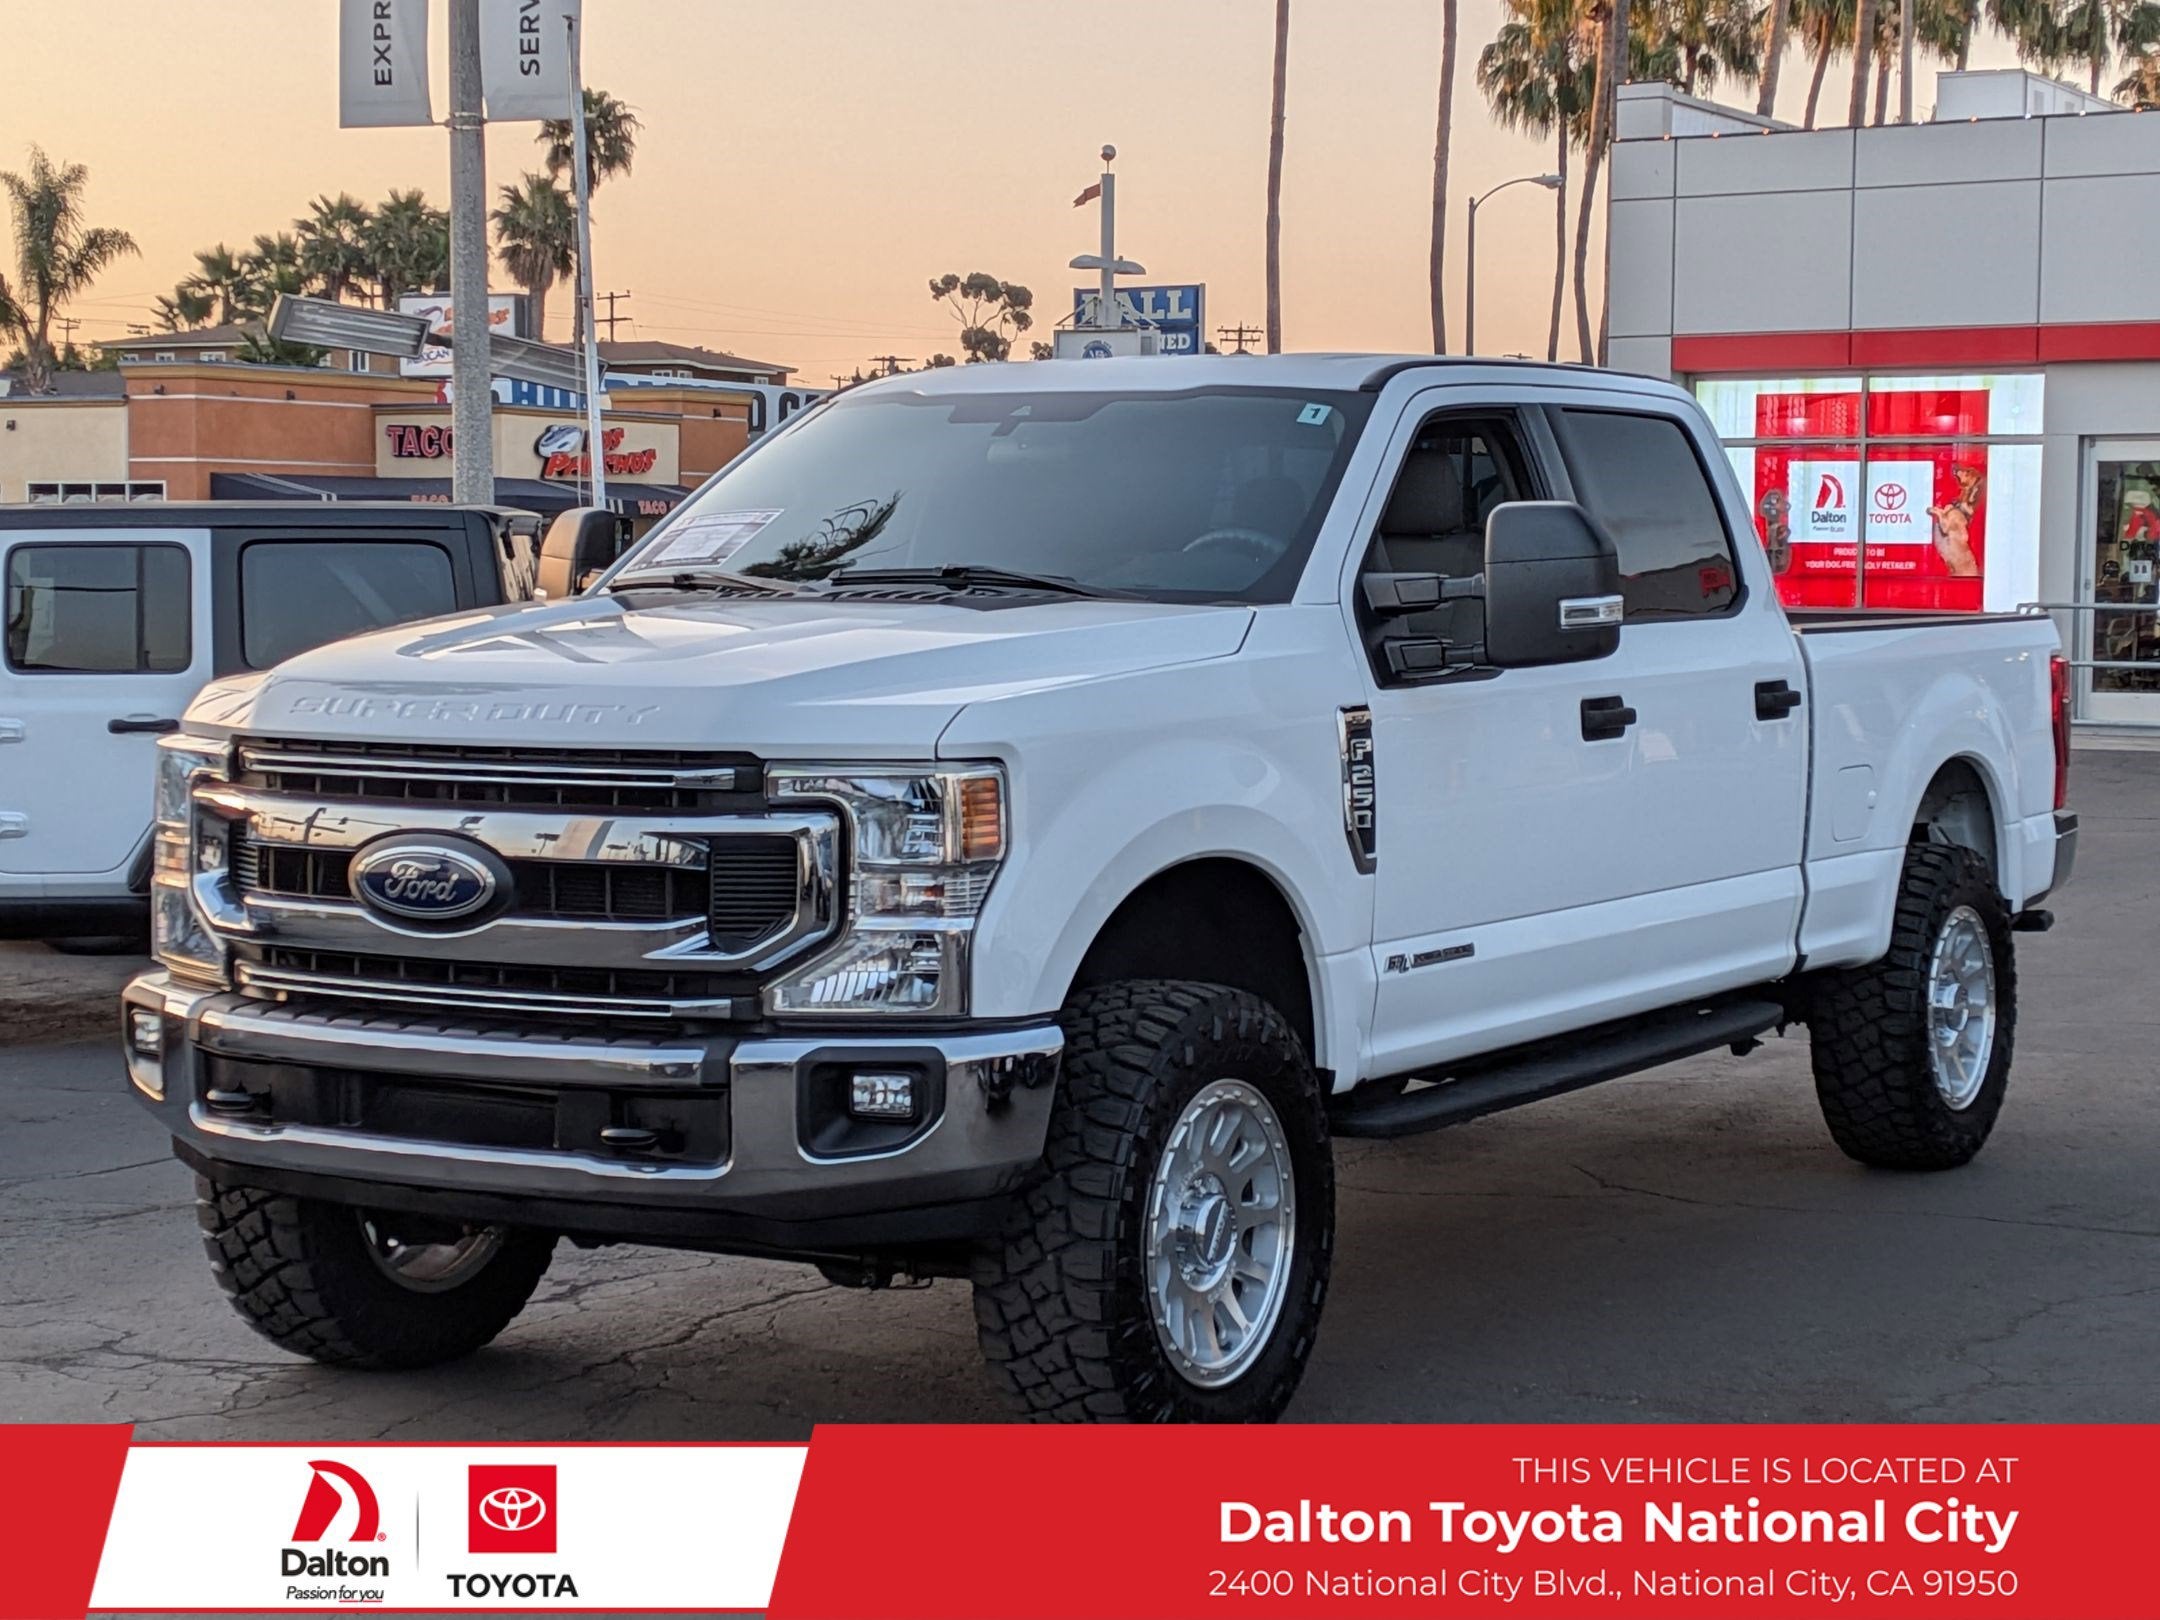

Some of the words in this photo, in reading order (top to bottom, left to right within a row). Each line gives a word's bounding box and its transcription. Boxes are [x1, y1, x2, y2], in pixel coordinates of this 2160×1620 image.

[374, 0, 393, 86] EXPR
[588, 428, 625, 455] OS
[1811, 510, 1847, 523] Dalton
[1869, 513, 1912, 524] TOYOTA
[1825, 560, 1881, 570] DOG-FRIEDLY
[288, 696, 479, 722] SUPER
[485, 700, 662, 726] DUTY
[1349, 737, 1374, 830] F250
[384, 860, 459, 901] Ford
